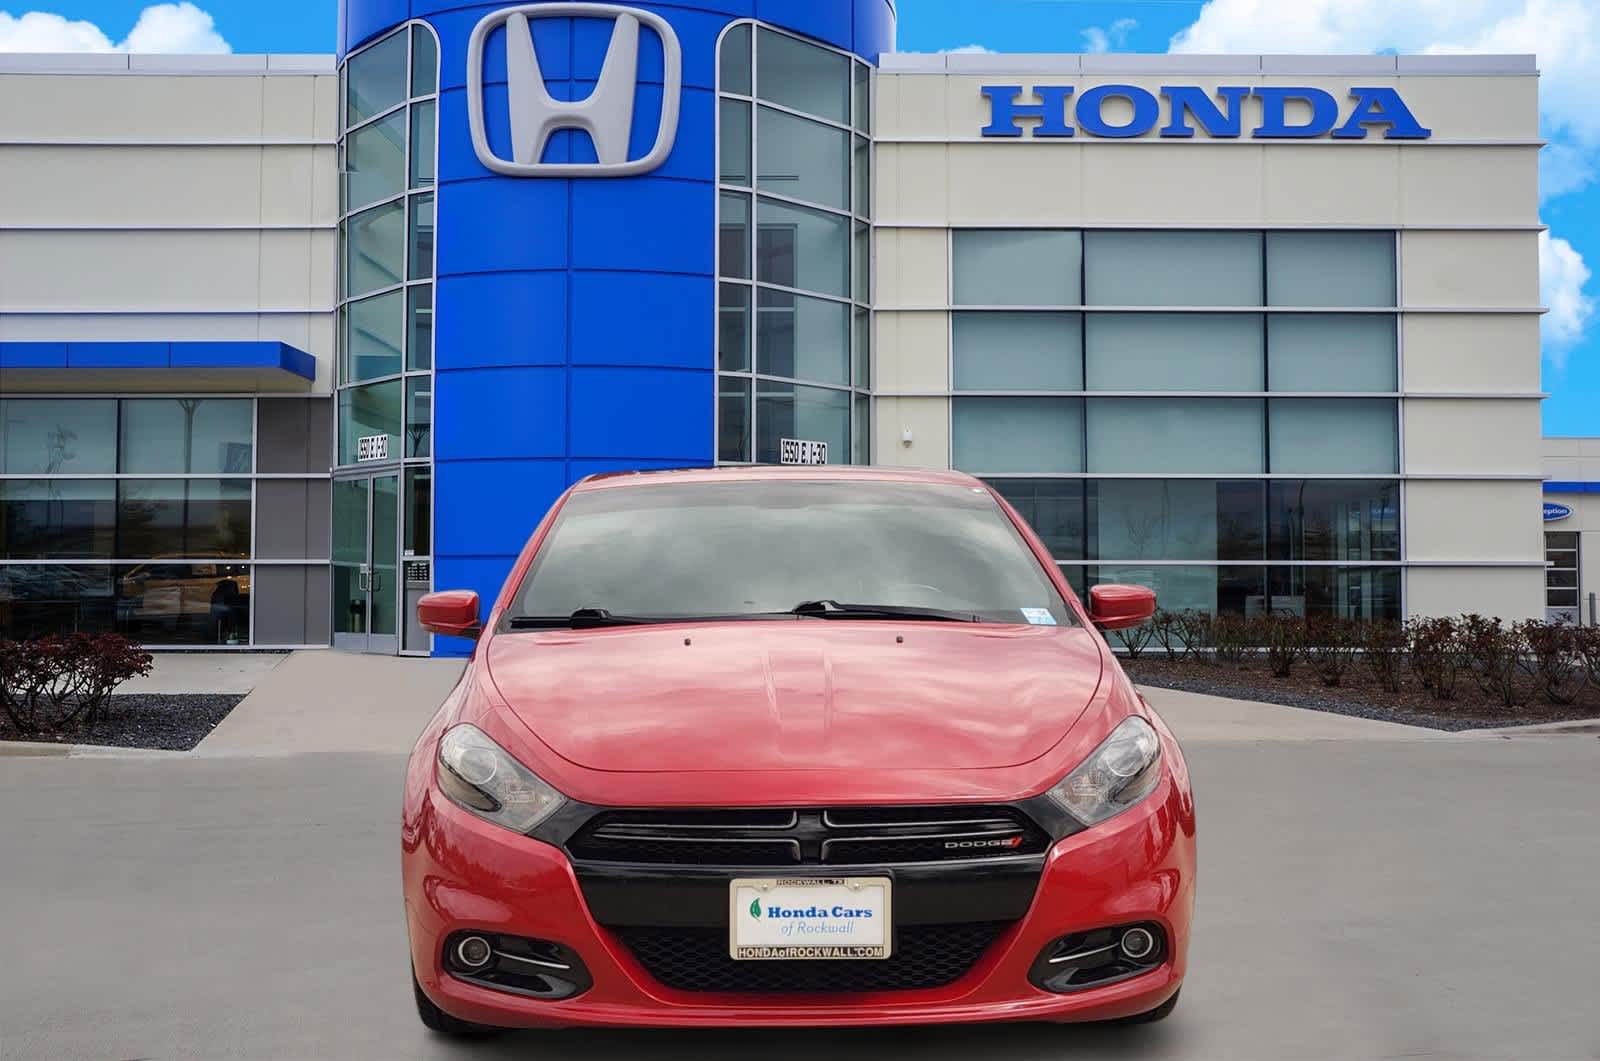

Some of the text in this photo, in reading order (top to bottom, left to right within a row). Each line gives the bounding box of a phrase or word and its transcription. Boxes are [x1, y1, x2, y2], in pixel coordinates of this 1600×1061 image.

[981, 84, 1432, 139] HONDA
[782, 440, 799, 463] 1550
[810, 443, 826, 464] I-30
[944, 840, 1013, 848] DODGE
[767, 906, 873, 918] Honda Cars
[780, 920, 855, 936] of Rockwall
